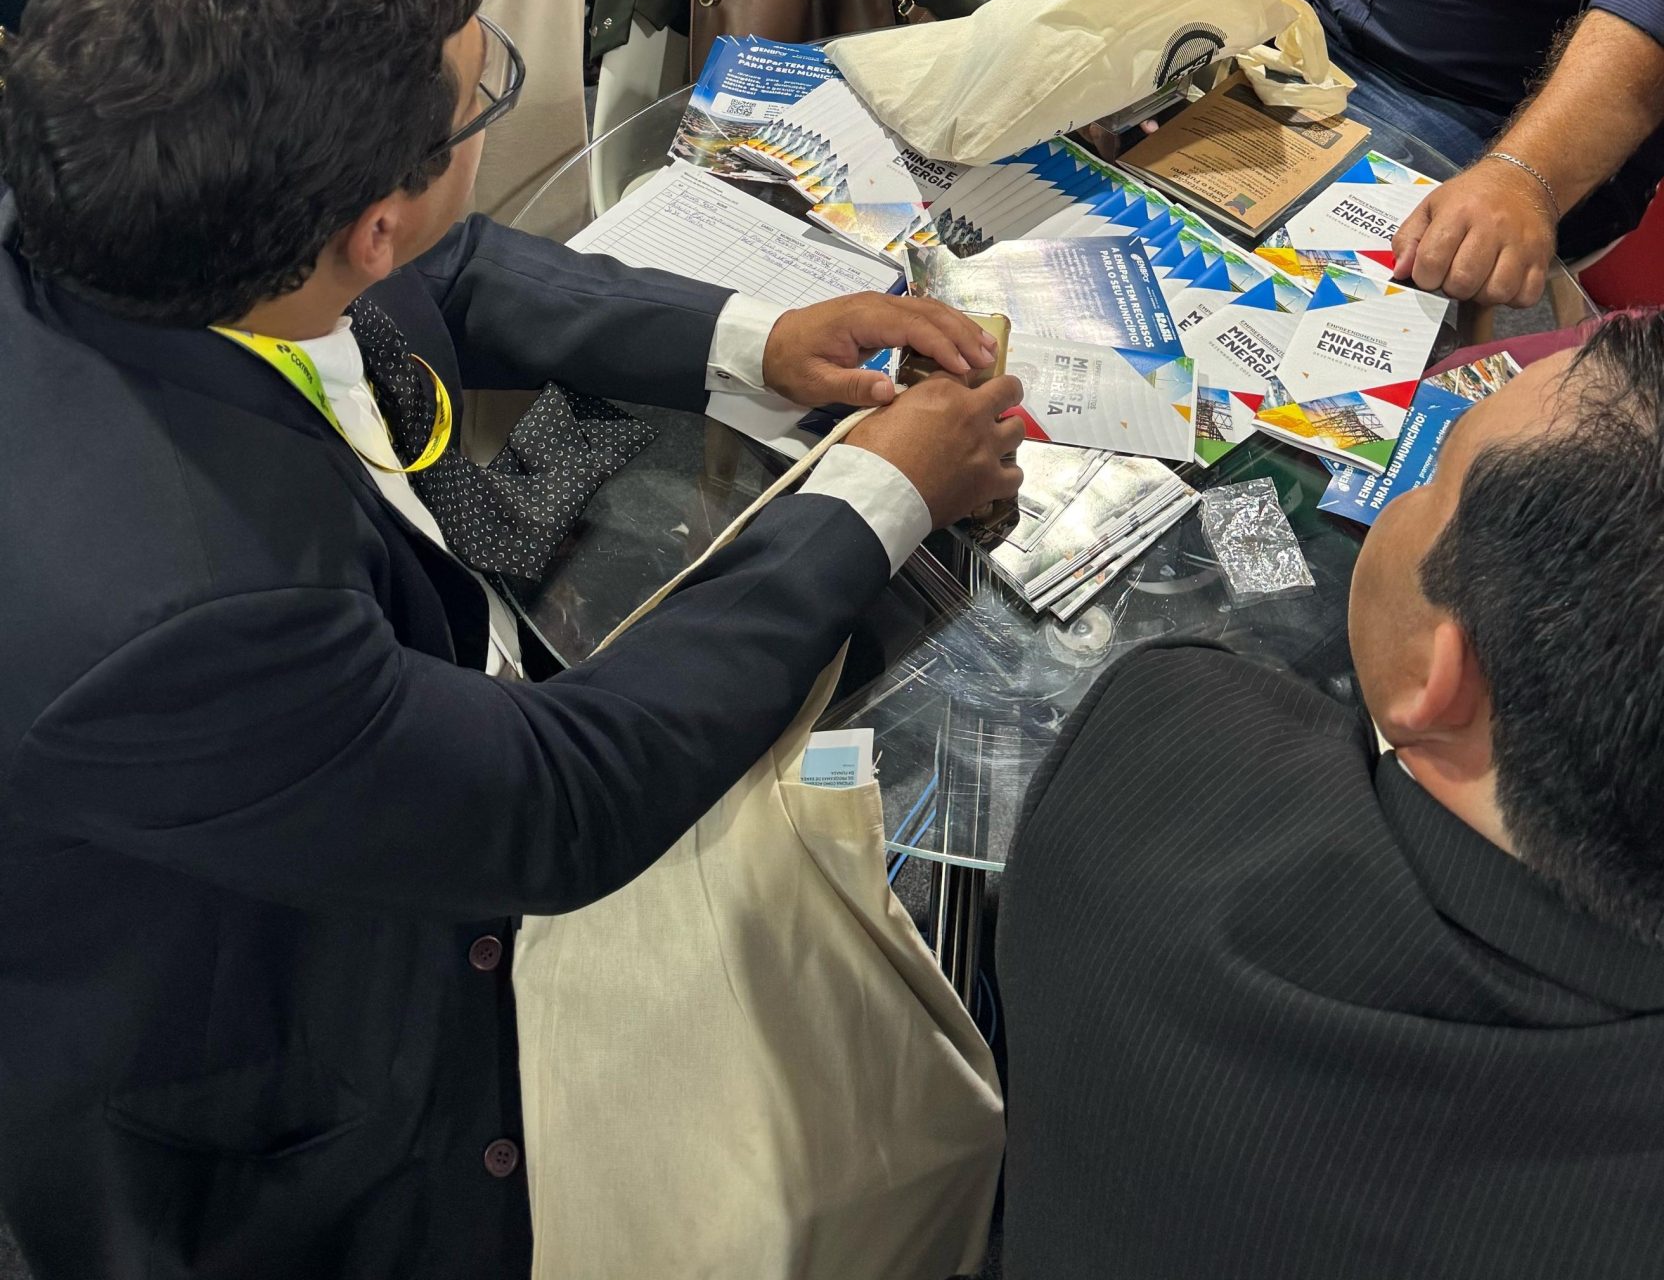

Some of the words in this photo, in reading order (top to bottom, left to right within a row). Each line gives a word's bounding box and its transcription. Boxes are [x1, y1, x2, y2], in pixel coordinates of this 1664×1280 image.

[738, 59, 764, 70] PARA
[746, 55, 784, 66] ENBPar
[784, 61, 806, 70] TEM
[892, 156, 953, 191] ENERGIA
[901, 148, 946, 176] MINAS
[945, 171, 958, 182] E
[1171, 174, 1223, 204] Capacitação
[1209, 185, 1229, 200] para
[1332, 206, 1394, 242] ENERGIA
[1339, 199, 1388, 227] MINAS
[1387, 223, 1400, 233] E
[1100, 249, 1114, 271] PARA
[1111, 247, 1121, 255] A
[1113, 254, 1130, 284] ENBPar
[1110, 279, 1123, 296] SEU
[1124, 284, 1139, 305] TEM
[1116, 295, 1142, 347] MUNICÍPIO!
[1130, 302, 1155, 349] RECURSOS
[1216, 333, 1278, 382] ENERGIA
[1226, 325, 1275, 365] MINAS
[1316, 341, 1393, 374] ENERGIA
[1321, 329, 1377, 356] MINAS
[1379, 349, 1393, 361] E
[1066, 404, 1082, 415] E
[1396, 412, 1428, 463] MUNICÍPIO!
[1385, 477, 1394, 486] O
[1388, 463, 1403, 479] SEU
[1354, 498, 1366, 507] A
[1370, 485, 1390, 509] PARA
